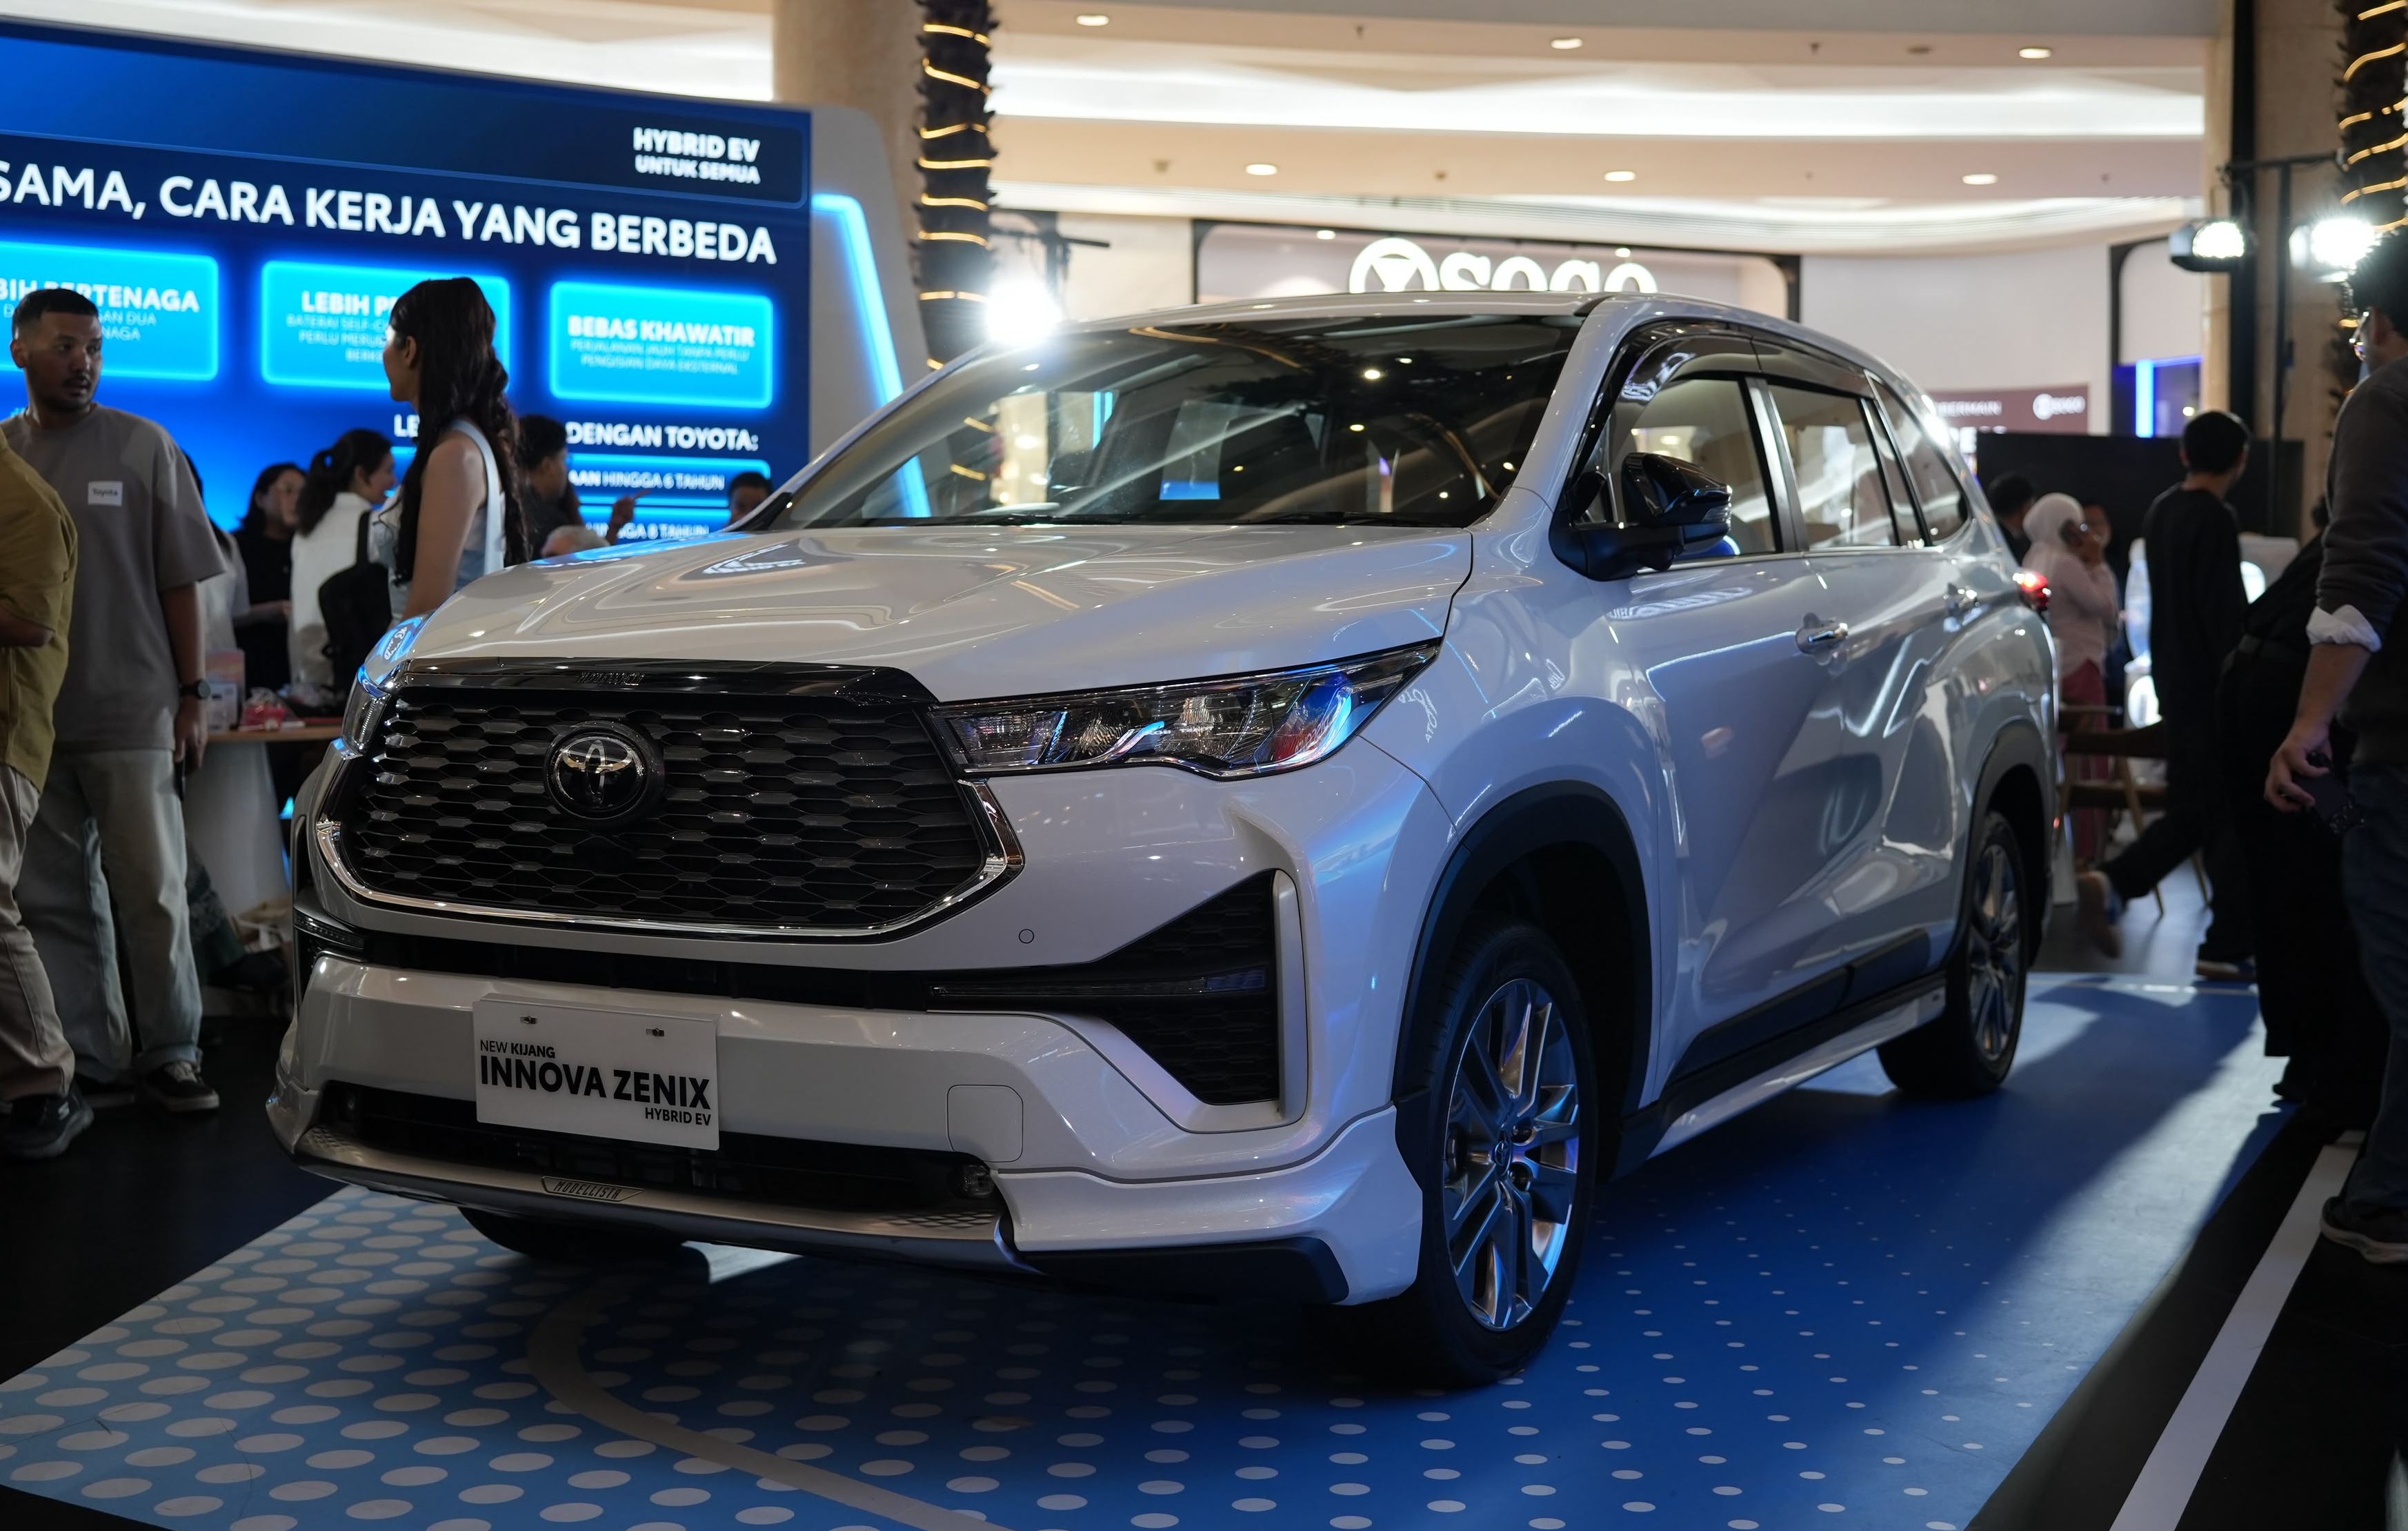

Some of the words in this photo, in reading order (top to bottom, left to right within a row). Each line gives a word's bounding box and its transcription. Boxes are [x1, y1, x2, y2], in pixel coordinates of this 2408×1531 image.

[633, 127, 726, 158] HYBRID
[728, 137, 761, 163] EV
[635, 154, 698, 178] UNTUK
[699, 161, 761, 185] SEMUA
[159, 176, 294, 226] CARA
[305, 188, 446, 239] KERJA
[452, 201, 580, 250] YANG
[591, 213, 777, 265] BERBEDA
[301, 290, 370, 317] LEBIH
[568, 315, 638, 340] BEBAS
[640, 319, 756, 348] KHAWATIR
[565, 421, 662, 448] DENGAN
[664, 425, 759, 452] TOYOTA:
[602, 471, 663, 489] HINGGA
[675, 472, 725, 491] TAHUN
[480, 1039, 508, 1054] NEW
[510, 1043, 556, 1059] KIJANG
[481, 1055, 607, 1098] INNOVA
[613, 1069, 711, 1109] ZENIX
[645, 1107, 693, 1124] HYBRID
[695, 1112, 712, 1126] EV
[553, 1181, 622, 1200] MODELLISTA
